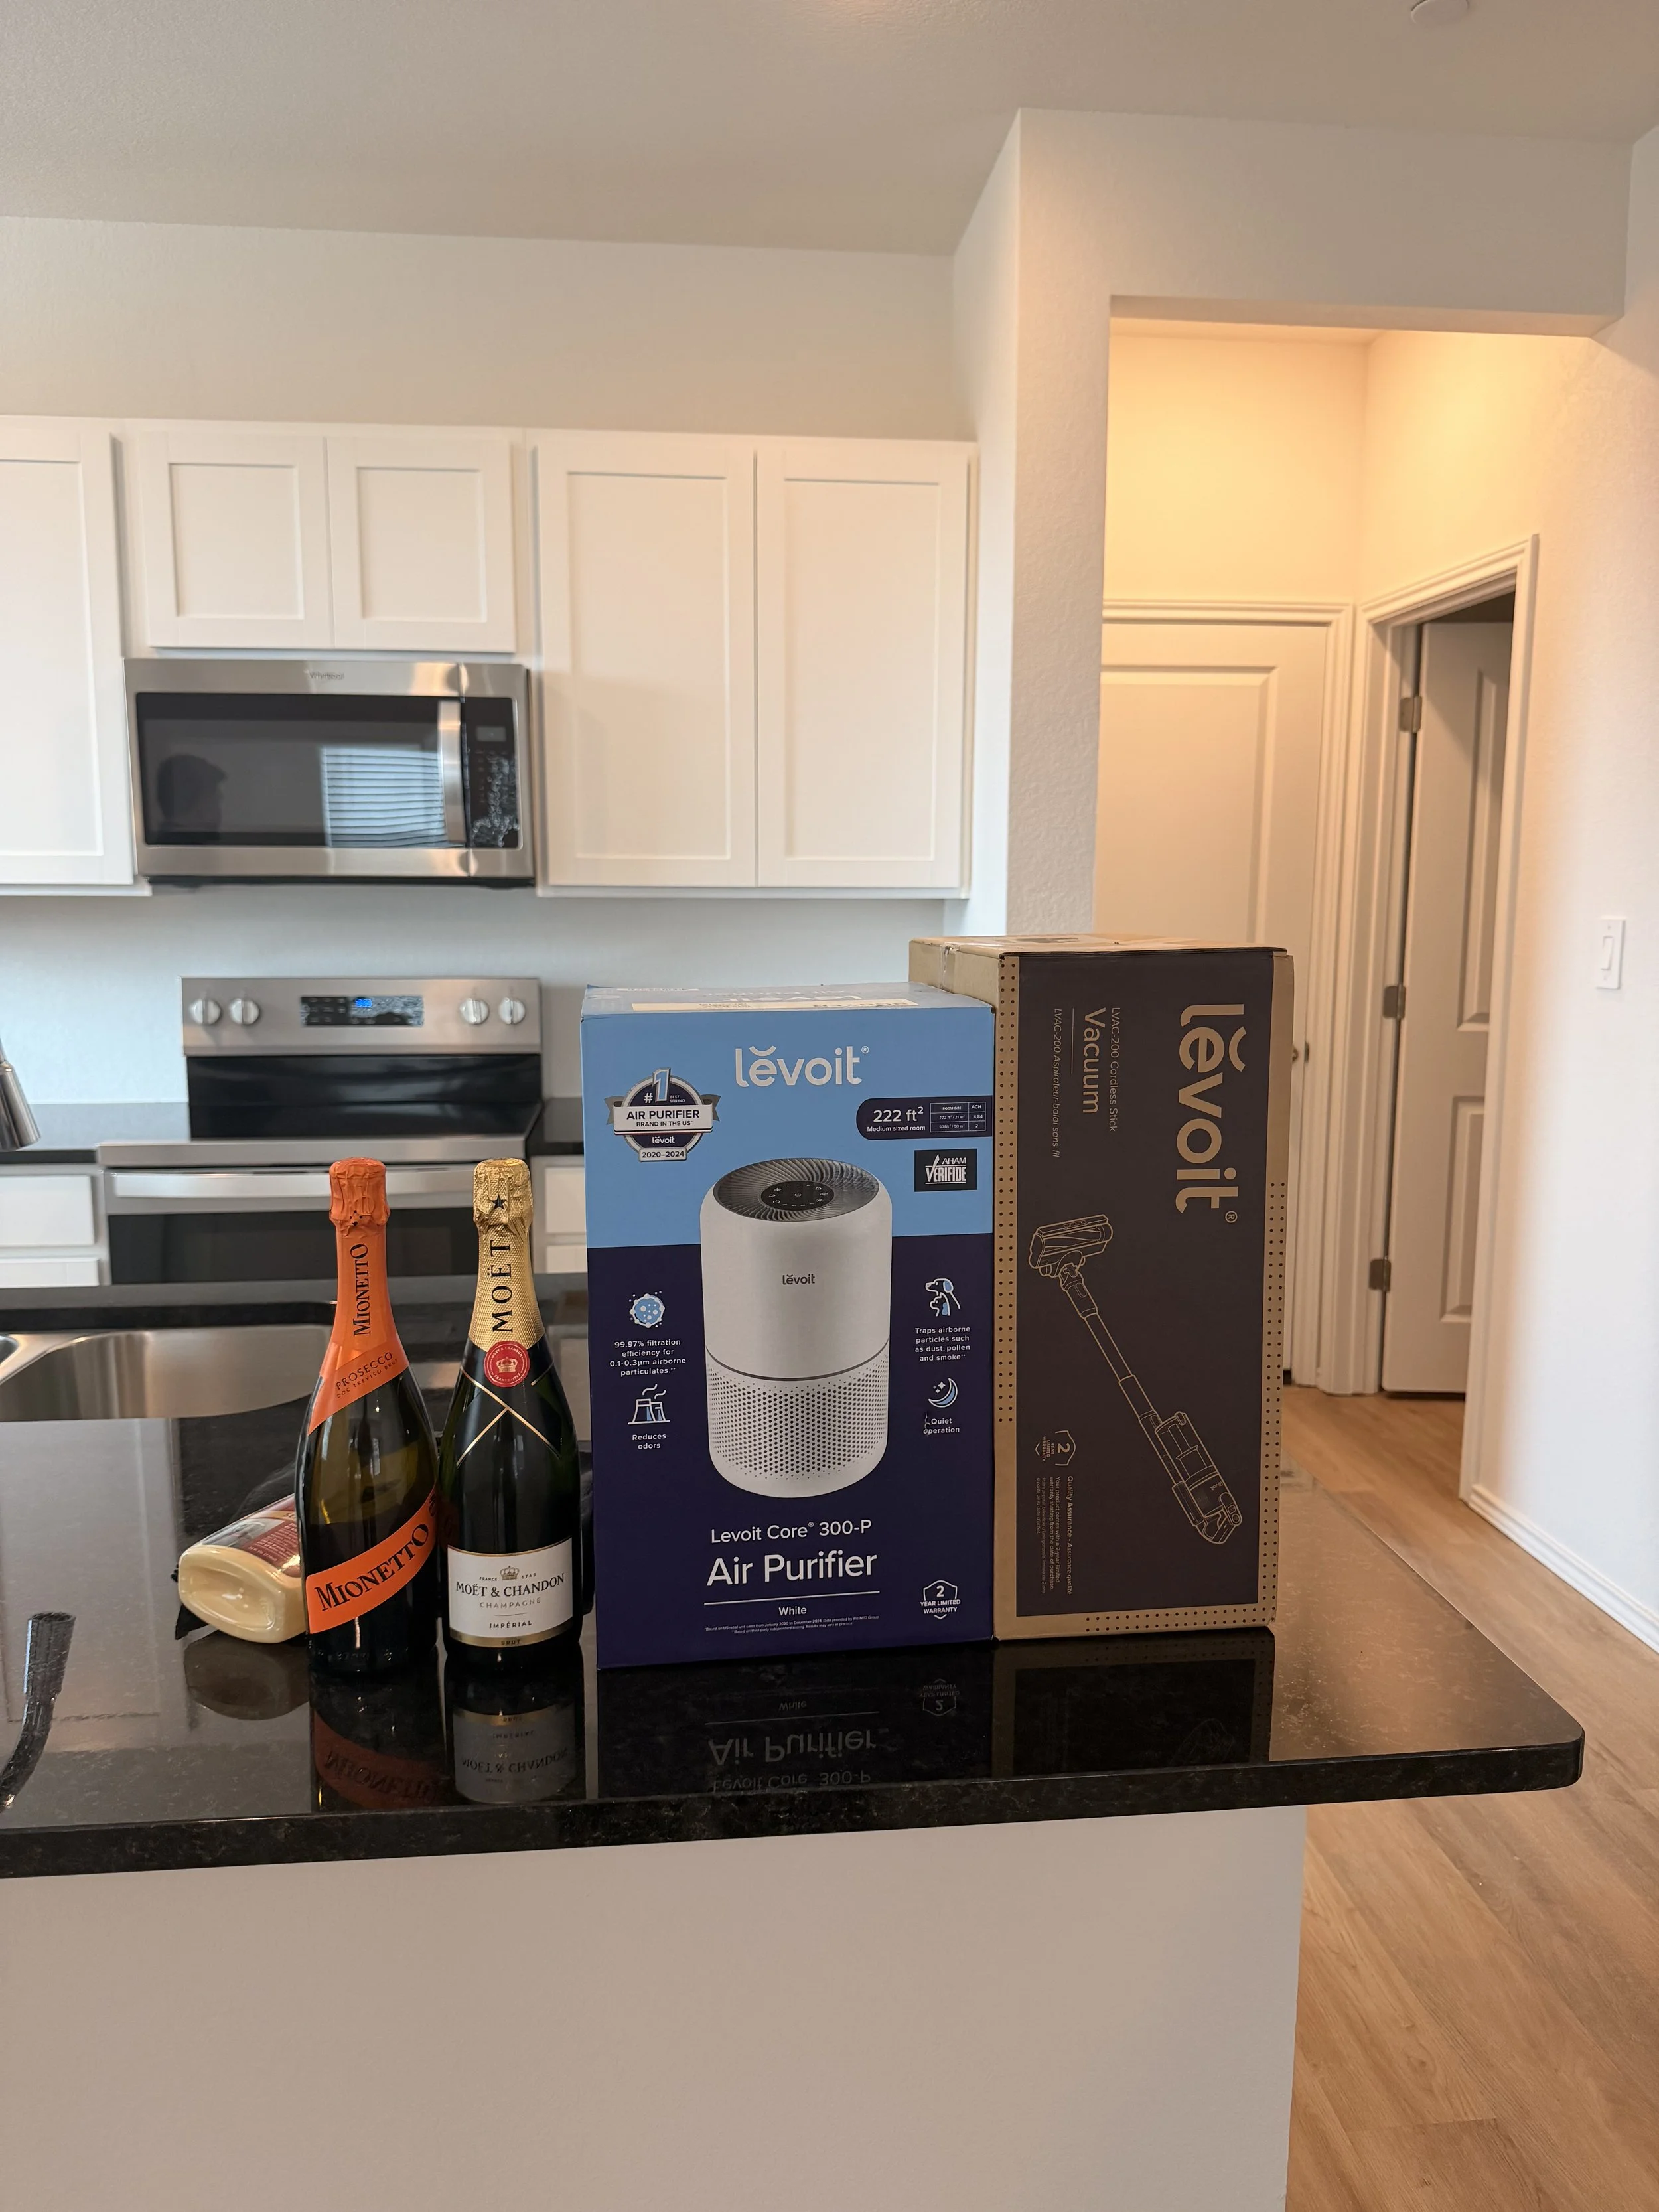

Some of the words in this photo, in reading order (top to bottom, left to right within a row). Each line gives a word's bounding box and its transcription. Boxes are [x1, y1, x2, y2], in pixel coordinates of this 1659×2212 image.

[1111, 1007, 1120, 1058] LVAC-200
[1083, 1007, 1106, 1113] Vacuum
[1052, 1055, 1061, 1125] Aspirateur-balai
[1110, 1061, 1119, 1105] Cordless
[626, 1111, 645, 1120] AIR
[649, 1110, 700, 1119] PURIFIER
[873, 1109, 902, 1123] 222
[1110, 1108, 1118, 1132] Stick
[926, 1154, 967, 1183] VERIFIDE
[487, 1239, 514, 1333] MOËT
[916, 1336, 949, 1345] particles
[336, 1352, 392, 1390] PROSECCO
[336, 1388, 351, 1399] DOC
[632, 1432, 666, 1441] Reduces
[923, 1426, 960, 1435] operation
[638, 1441, 661, 1450] odors
[1058, 1443, 1070, 1453] 2
[711, 1526, 762, 1544] Levoit
[819, 1519, 872, 1537] 300-P
[707, 1556, 753, 1586] Air
[764, 1550, 877, 1583] Purifier
[456, 1582, 488, 1597] MOËT
[491, 1587, 500, 1597] &
[504, 1573, 565, 1597] CHANDON
[936, 1585, 944, 1597] 2
[480, 1597, 541, 1609] CHAMPAGNE
[778, 1606, 807, 1616] White
[490, 1621, 532, 1629] IMPÉRIAL
